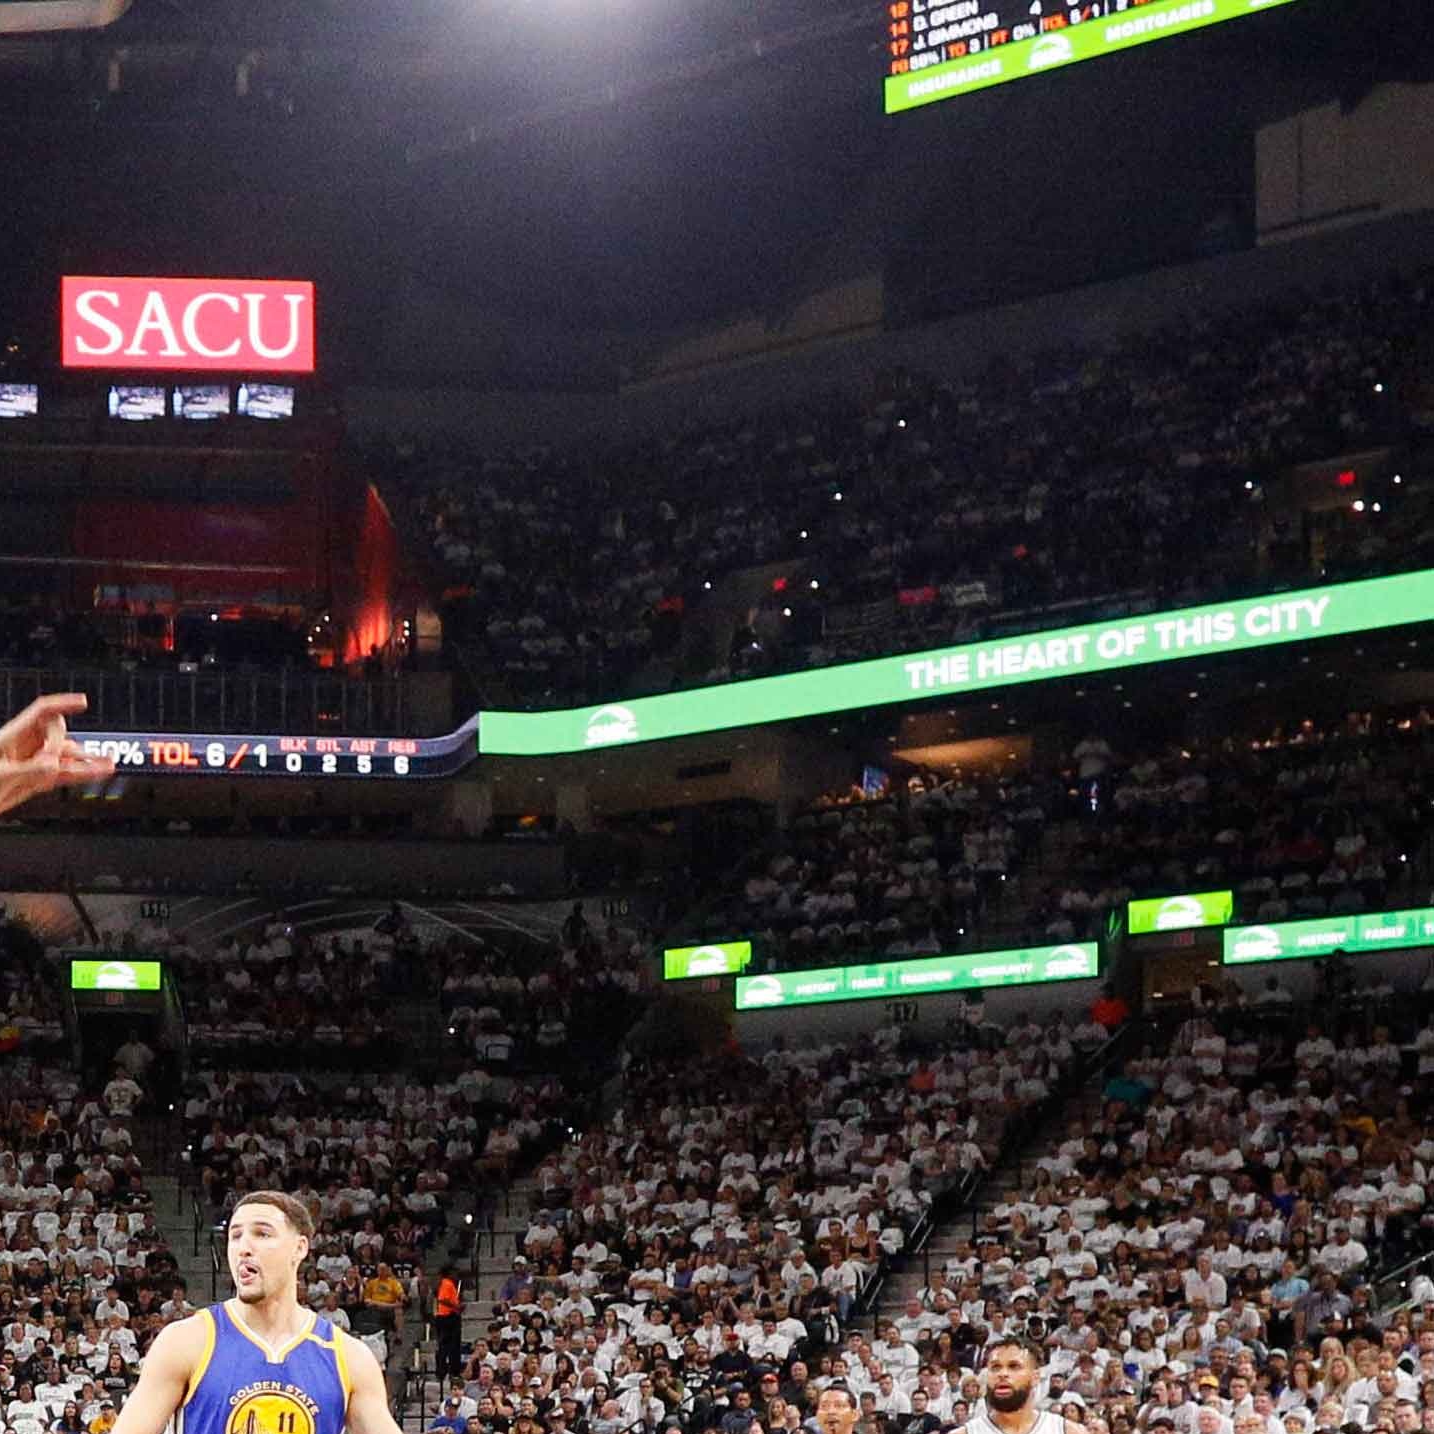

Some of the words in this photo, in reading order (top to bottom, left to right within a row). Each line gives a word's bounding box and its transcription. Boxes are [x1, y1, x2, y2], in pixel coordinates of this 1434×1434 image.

[73, 288, 306, 361] SACU
[905, 655, 970, 690] THE
[976, 634, 1089, 680] HEART
[1095, 629, 1146, 660] OF
[1153, 611, 1238, 652] THIS
[1242, 595, 1332, 638] CITY
[147, 742, 199, 767] TOL
[285, 754, 302, 773] 0
[321, 754, 338, 774] 2
[356, 755, 373, 774] 5
[393, 756, 409, 776] 6
[228, 1380, 282, 1407] GOLDEN
[285, 1382, 321, 1417] STATE
[278, 1411, 296, 1434] 11
